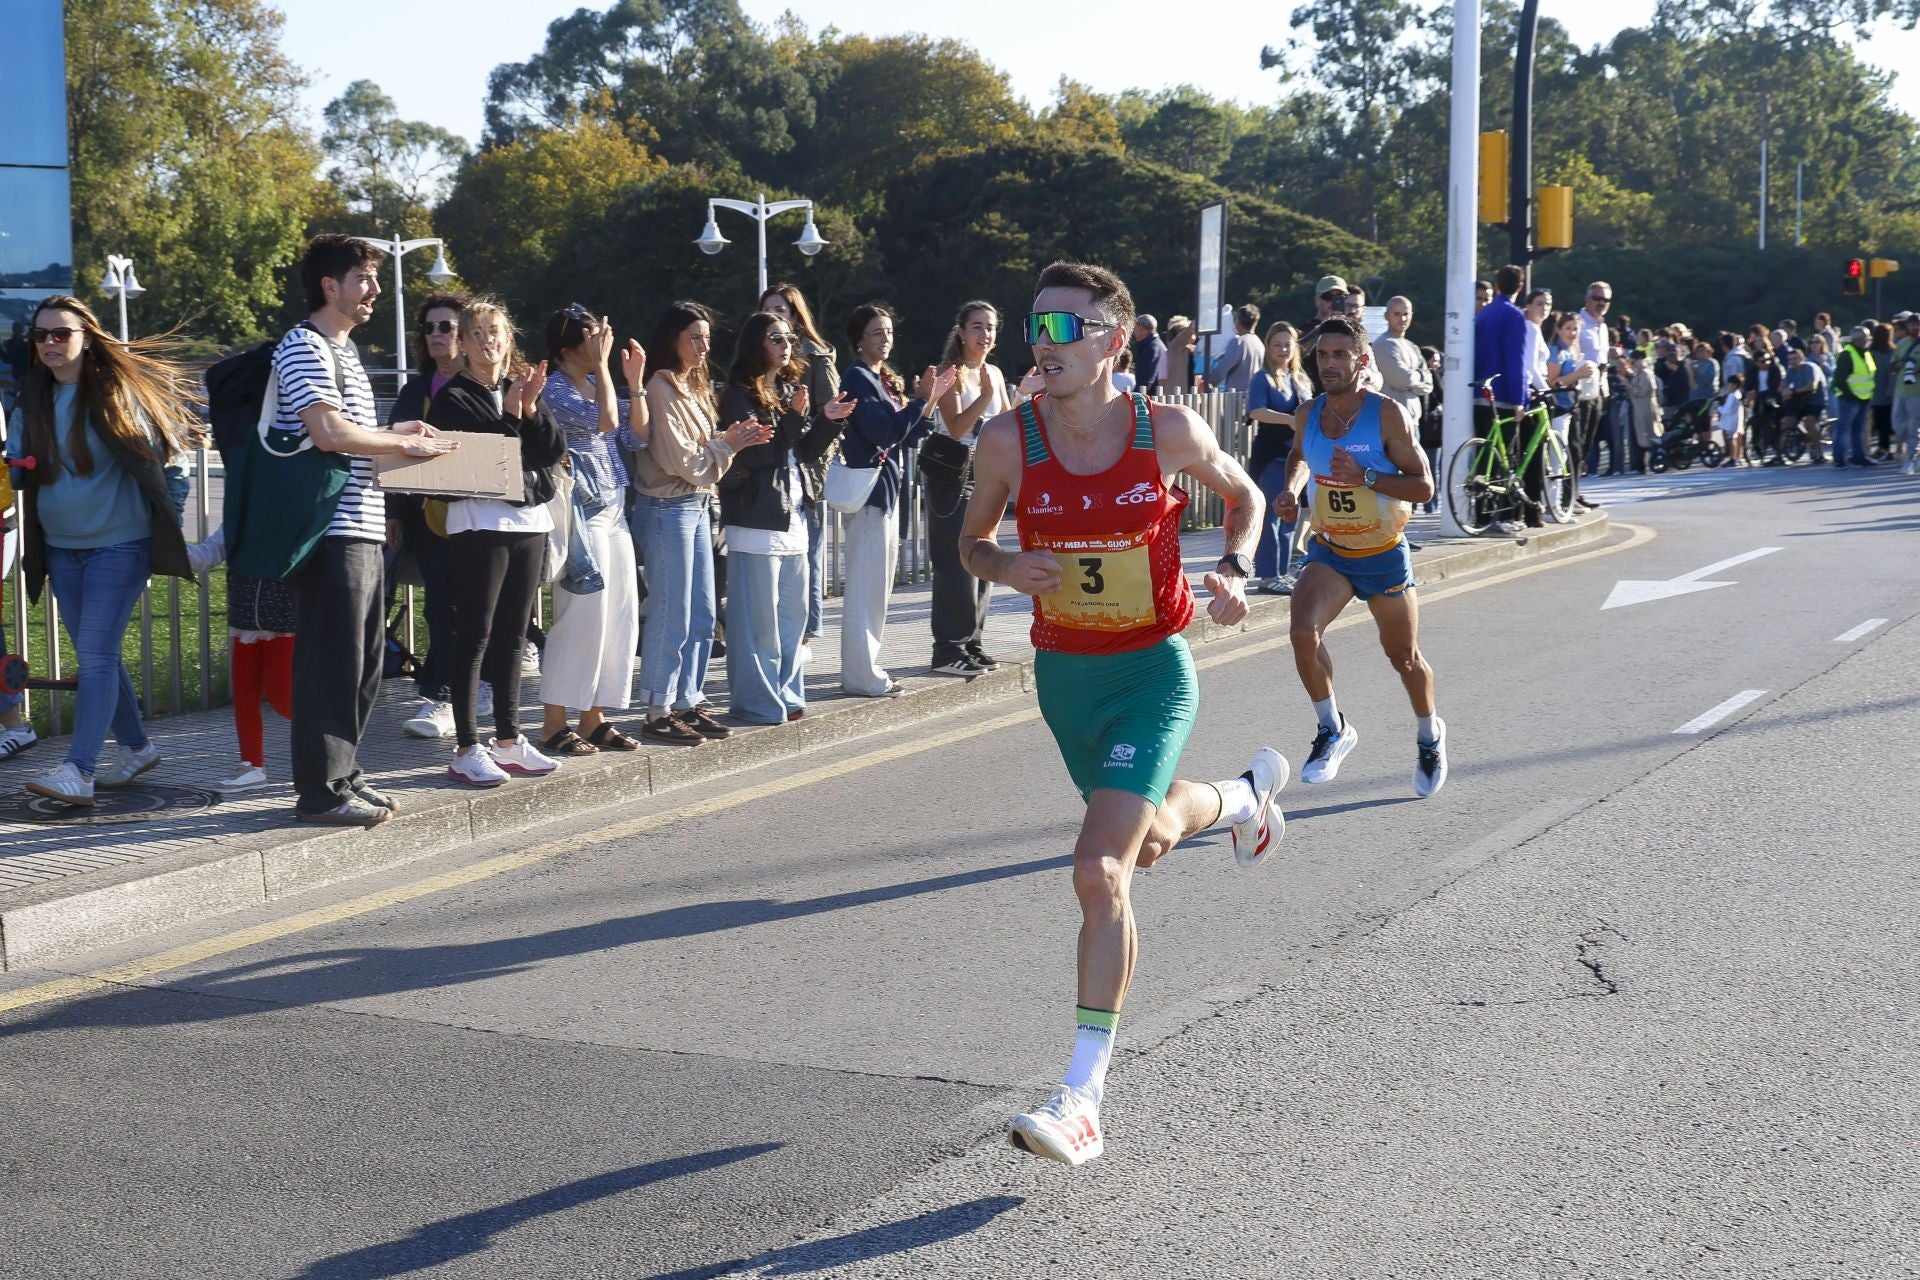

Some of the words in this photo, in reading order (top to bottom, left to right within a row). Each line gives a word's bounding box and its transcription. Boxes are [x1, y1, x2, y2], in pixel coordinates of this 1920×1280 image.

[1345, 444, 1370, 452] HOKA
[1115, 492, 1158, 505] coa
[1328, 490, 1356, 513] 65
[1064, 541, 1089, 549] MBA
[1079, 558, 1104, 594] 3
[1103, 760, 1134, 768] Llanes
